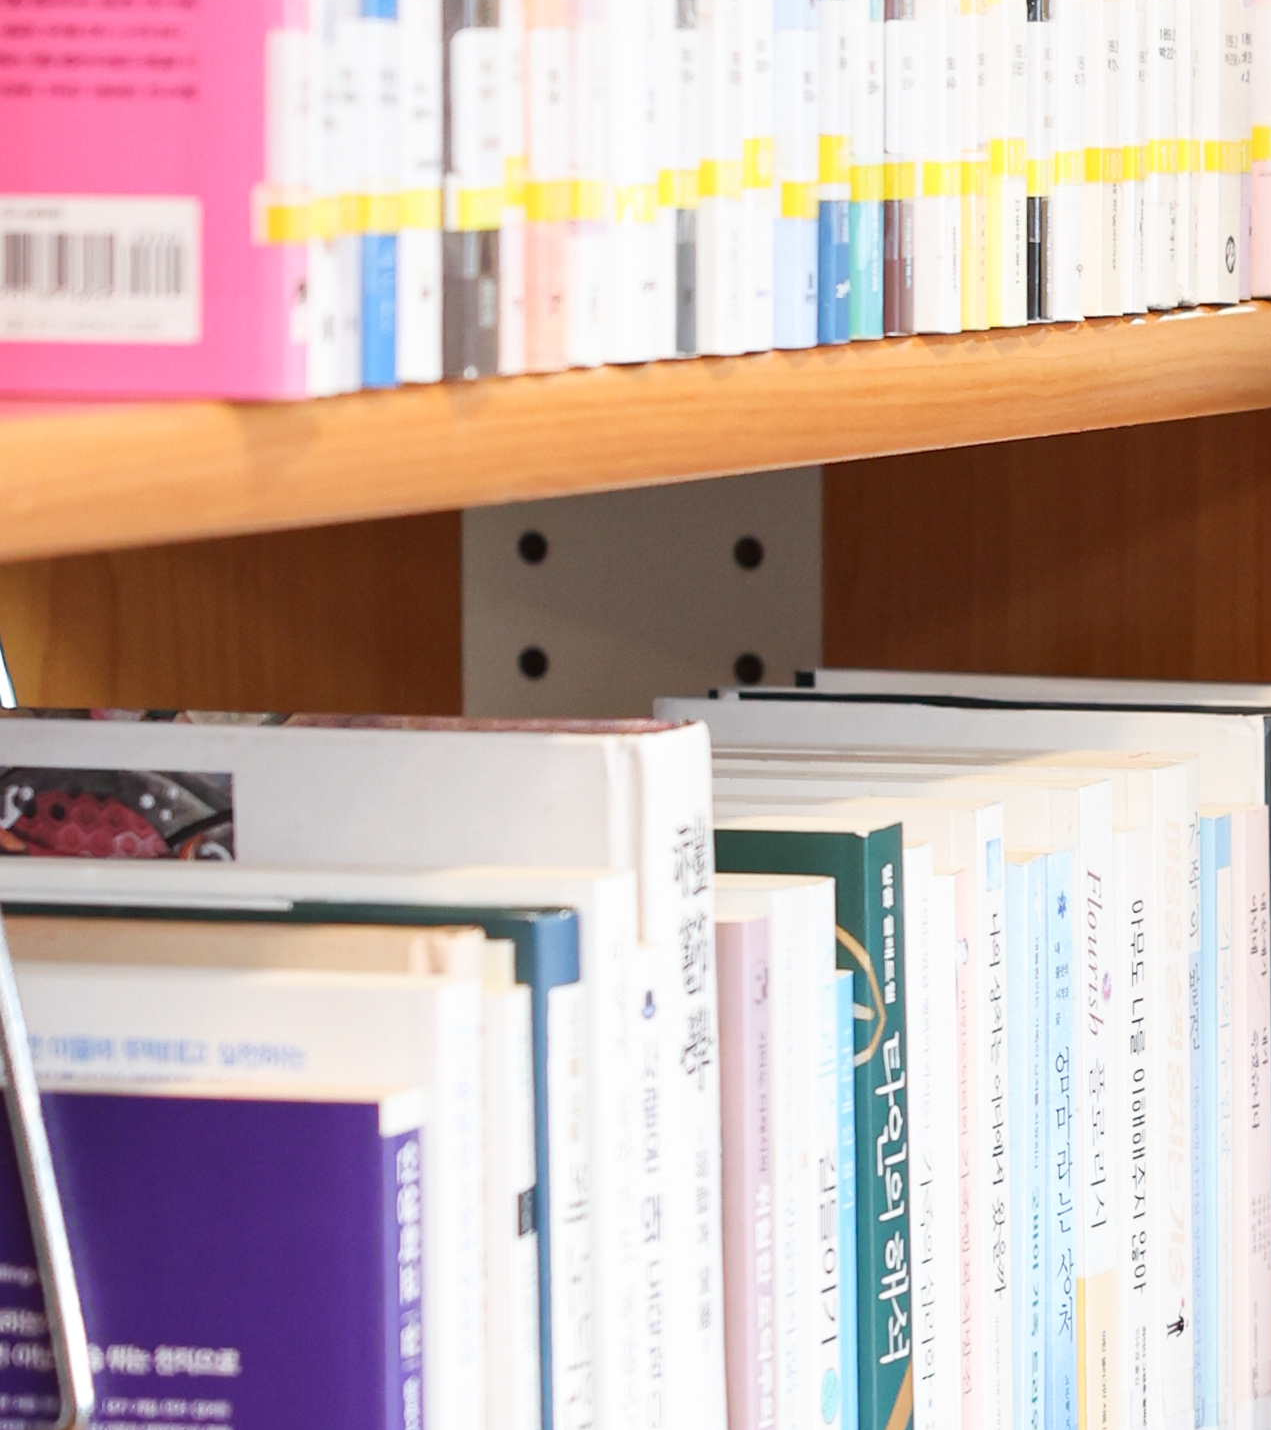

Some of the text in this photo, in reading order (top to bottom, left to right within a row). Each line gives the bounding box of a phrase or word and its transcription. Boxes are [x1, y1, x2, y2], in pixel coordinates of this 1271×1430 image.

[1086, 867, 1104, 1038] Flourish
[874, 1031, 911, 1367] 타인의 해석
[989, 912, 1008, 1296] 나의 상처는 어디에서 왔을까
[1056, 1047, 1075, 1234] 엄마라는
[1130, 898, 1147, 1294] 아무도 나를 이해해주지 않아
[1057, 1249, 1079, 1346] 상처
